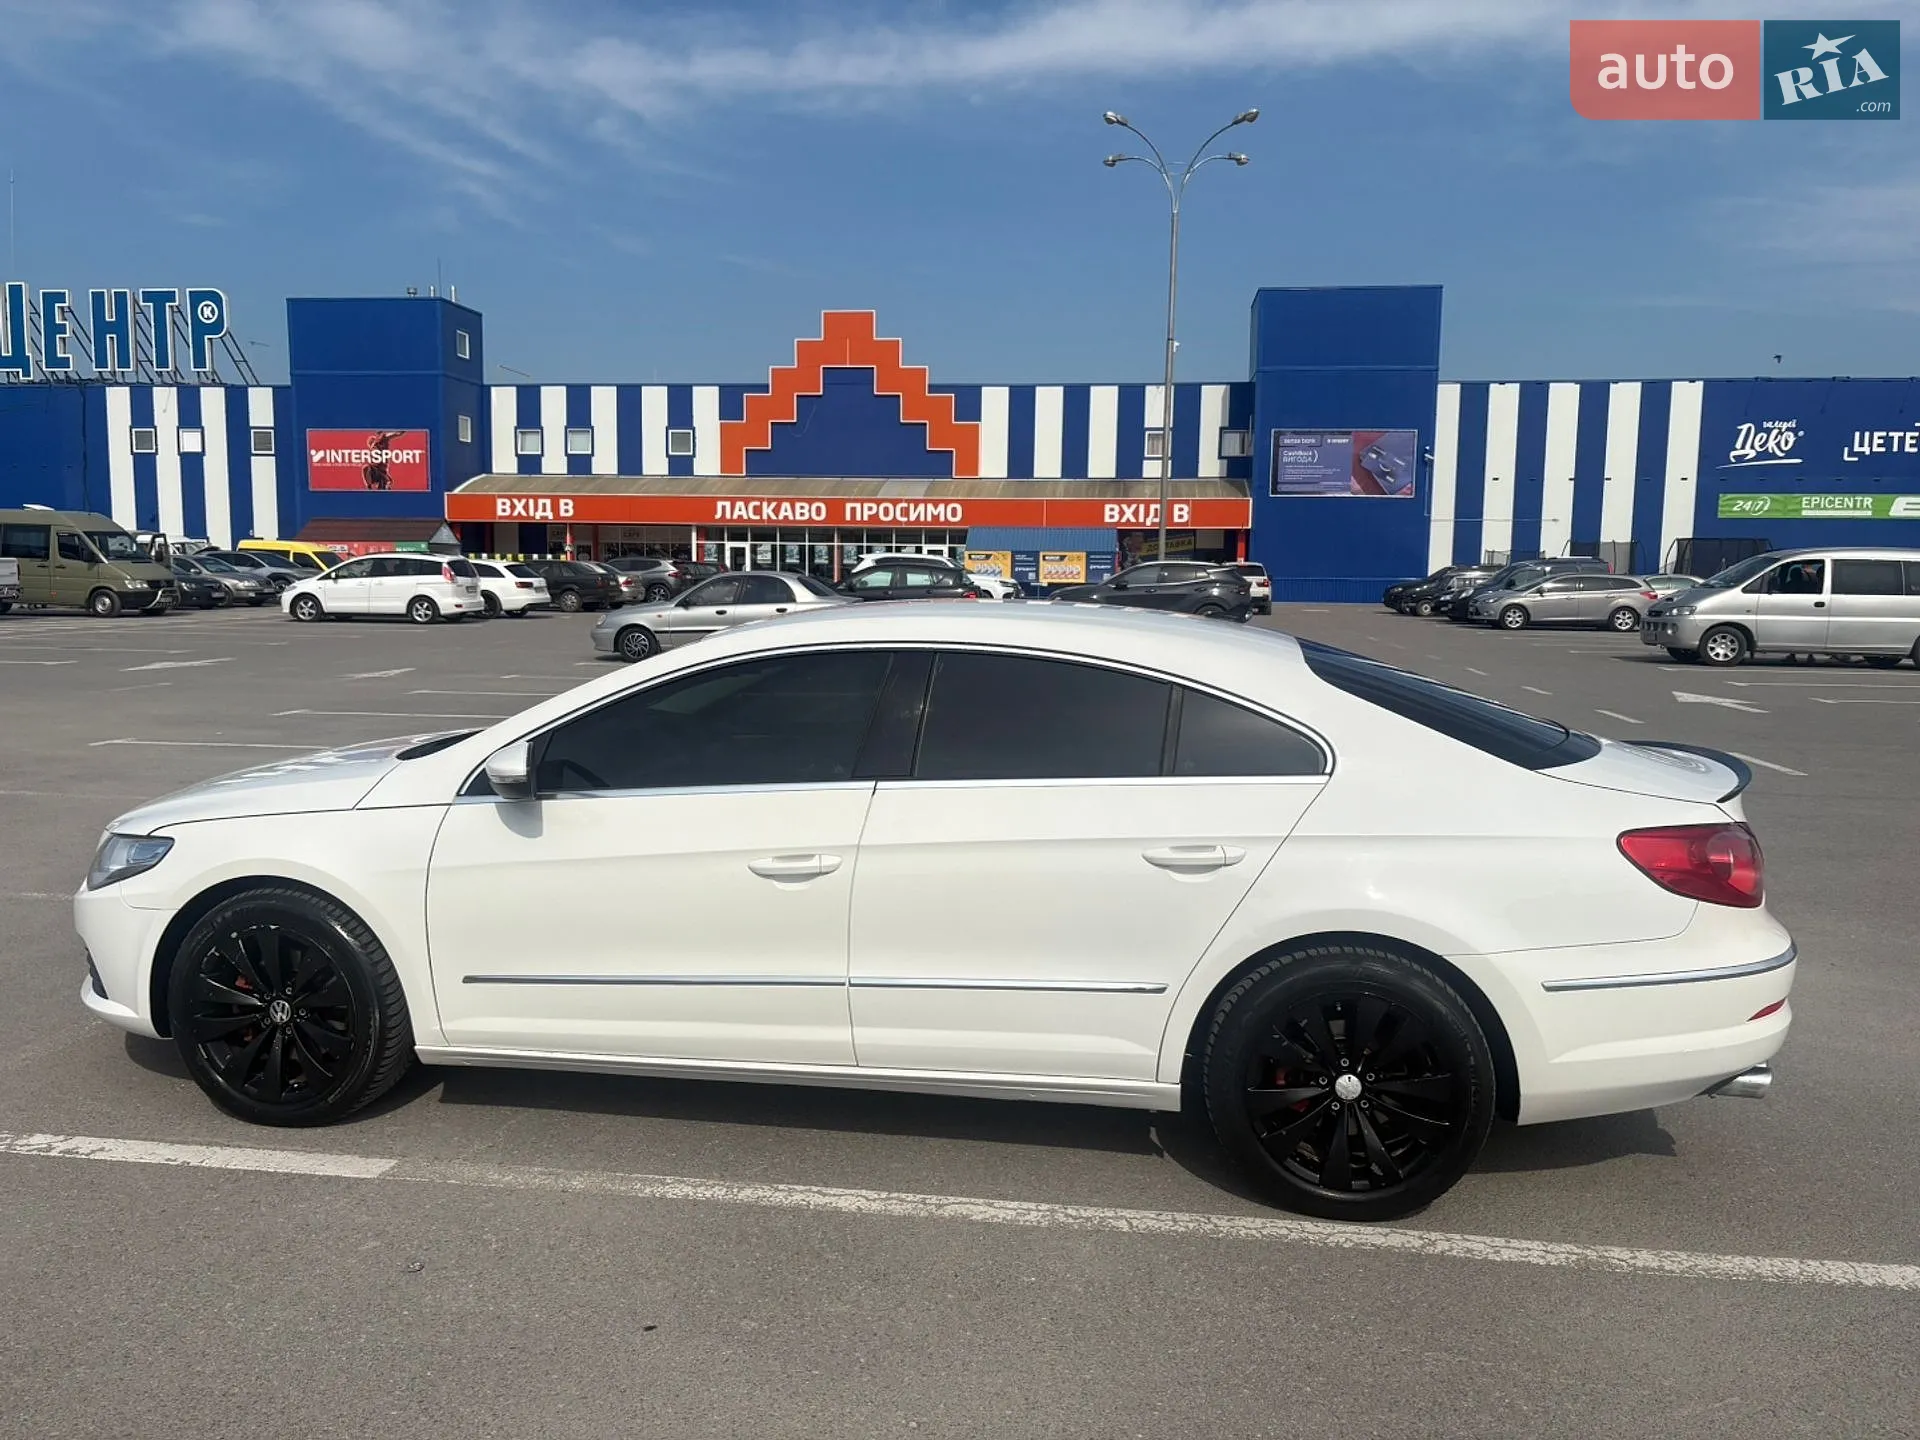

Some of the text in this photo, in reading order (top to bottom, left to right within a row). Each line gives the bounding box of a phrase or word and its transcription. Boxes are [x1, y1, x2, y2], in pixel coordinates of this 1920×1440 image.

[1729, 422, 1797, 463] Деко
[325, 448, 422, 464] INTERSPORT
[495, 498, 575, 520] ВХІД В
[714, 501, 963, 523] ЛАСКАВО ПРОСИМО
[1173, 503, 1190, 523] В
[1801, 496, 1873, 509] EPICENTR
